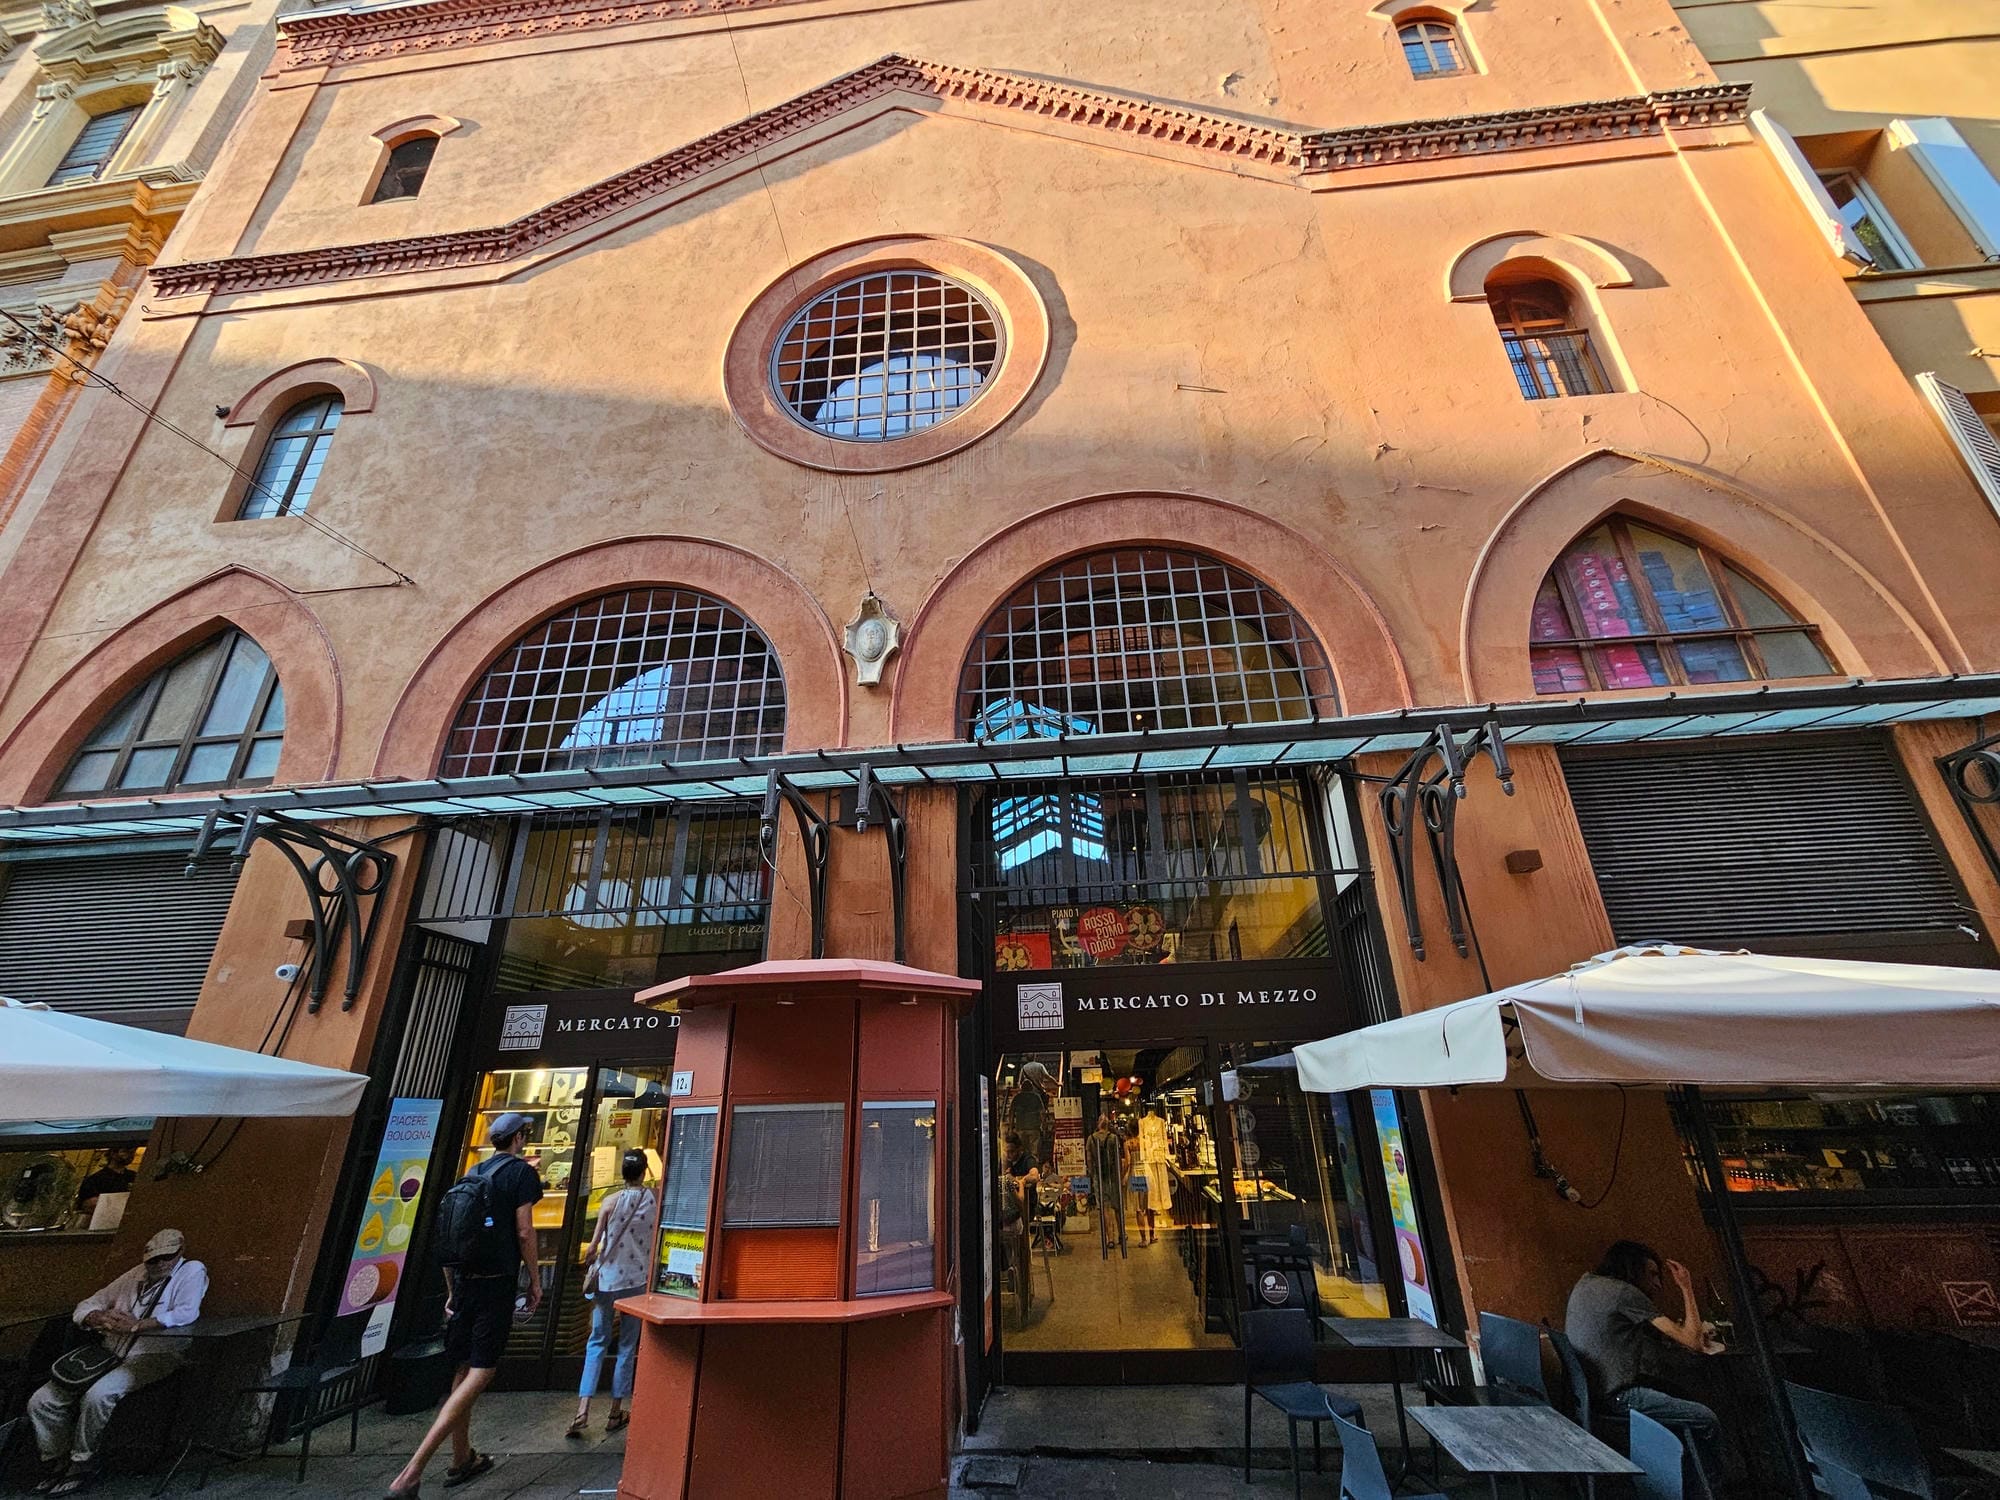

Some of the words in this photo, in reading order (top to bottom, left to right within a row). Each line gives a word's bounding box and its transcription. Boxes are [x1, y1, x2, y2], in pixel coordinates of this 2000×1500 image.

[1052, 908, 1074, 919] PIANO
[1075, 908, 1080, 917] 1
[1083, 912, 1116, 930] ROSSO
[688, 925, 726, 937] cucina
[728, 925, 736, 935] e
[1095, 923, 1124, 940] POMO
[1077, 993, 1190, 1012] MERCATO
[1199, 992, 1226, 1006] DI
[1237, 987, 1318, 1005] MEZZO
[556, 1015, 660, 1032] MERCATO
[386, 1130, 431, 1141] BOLOGNA
